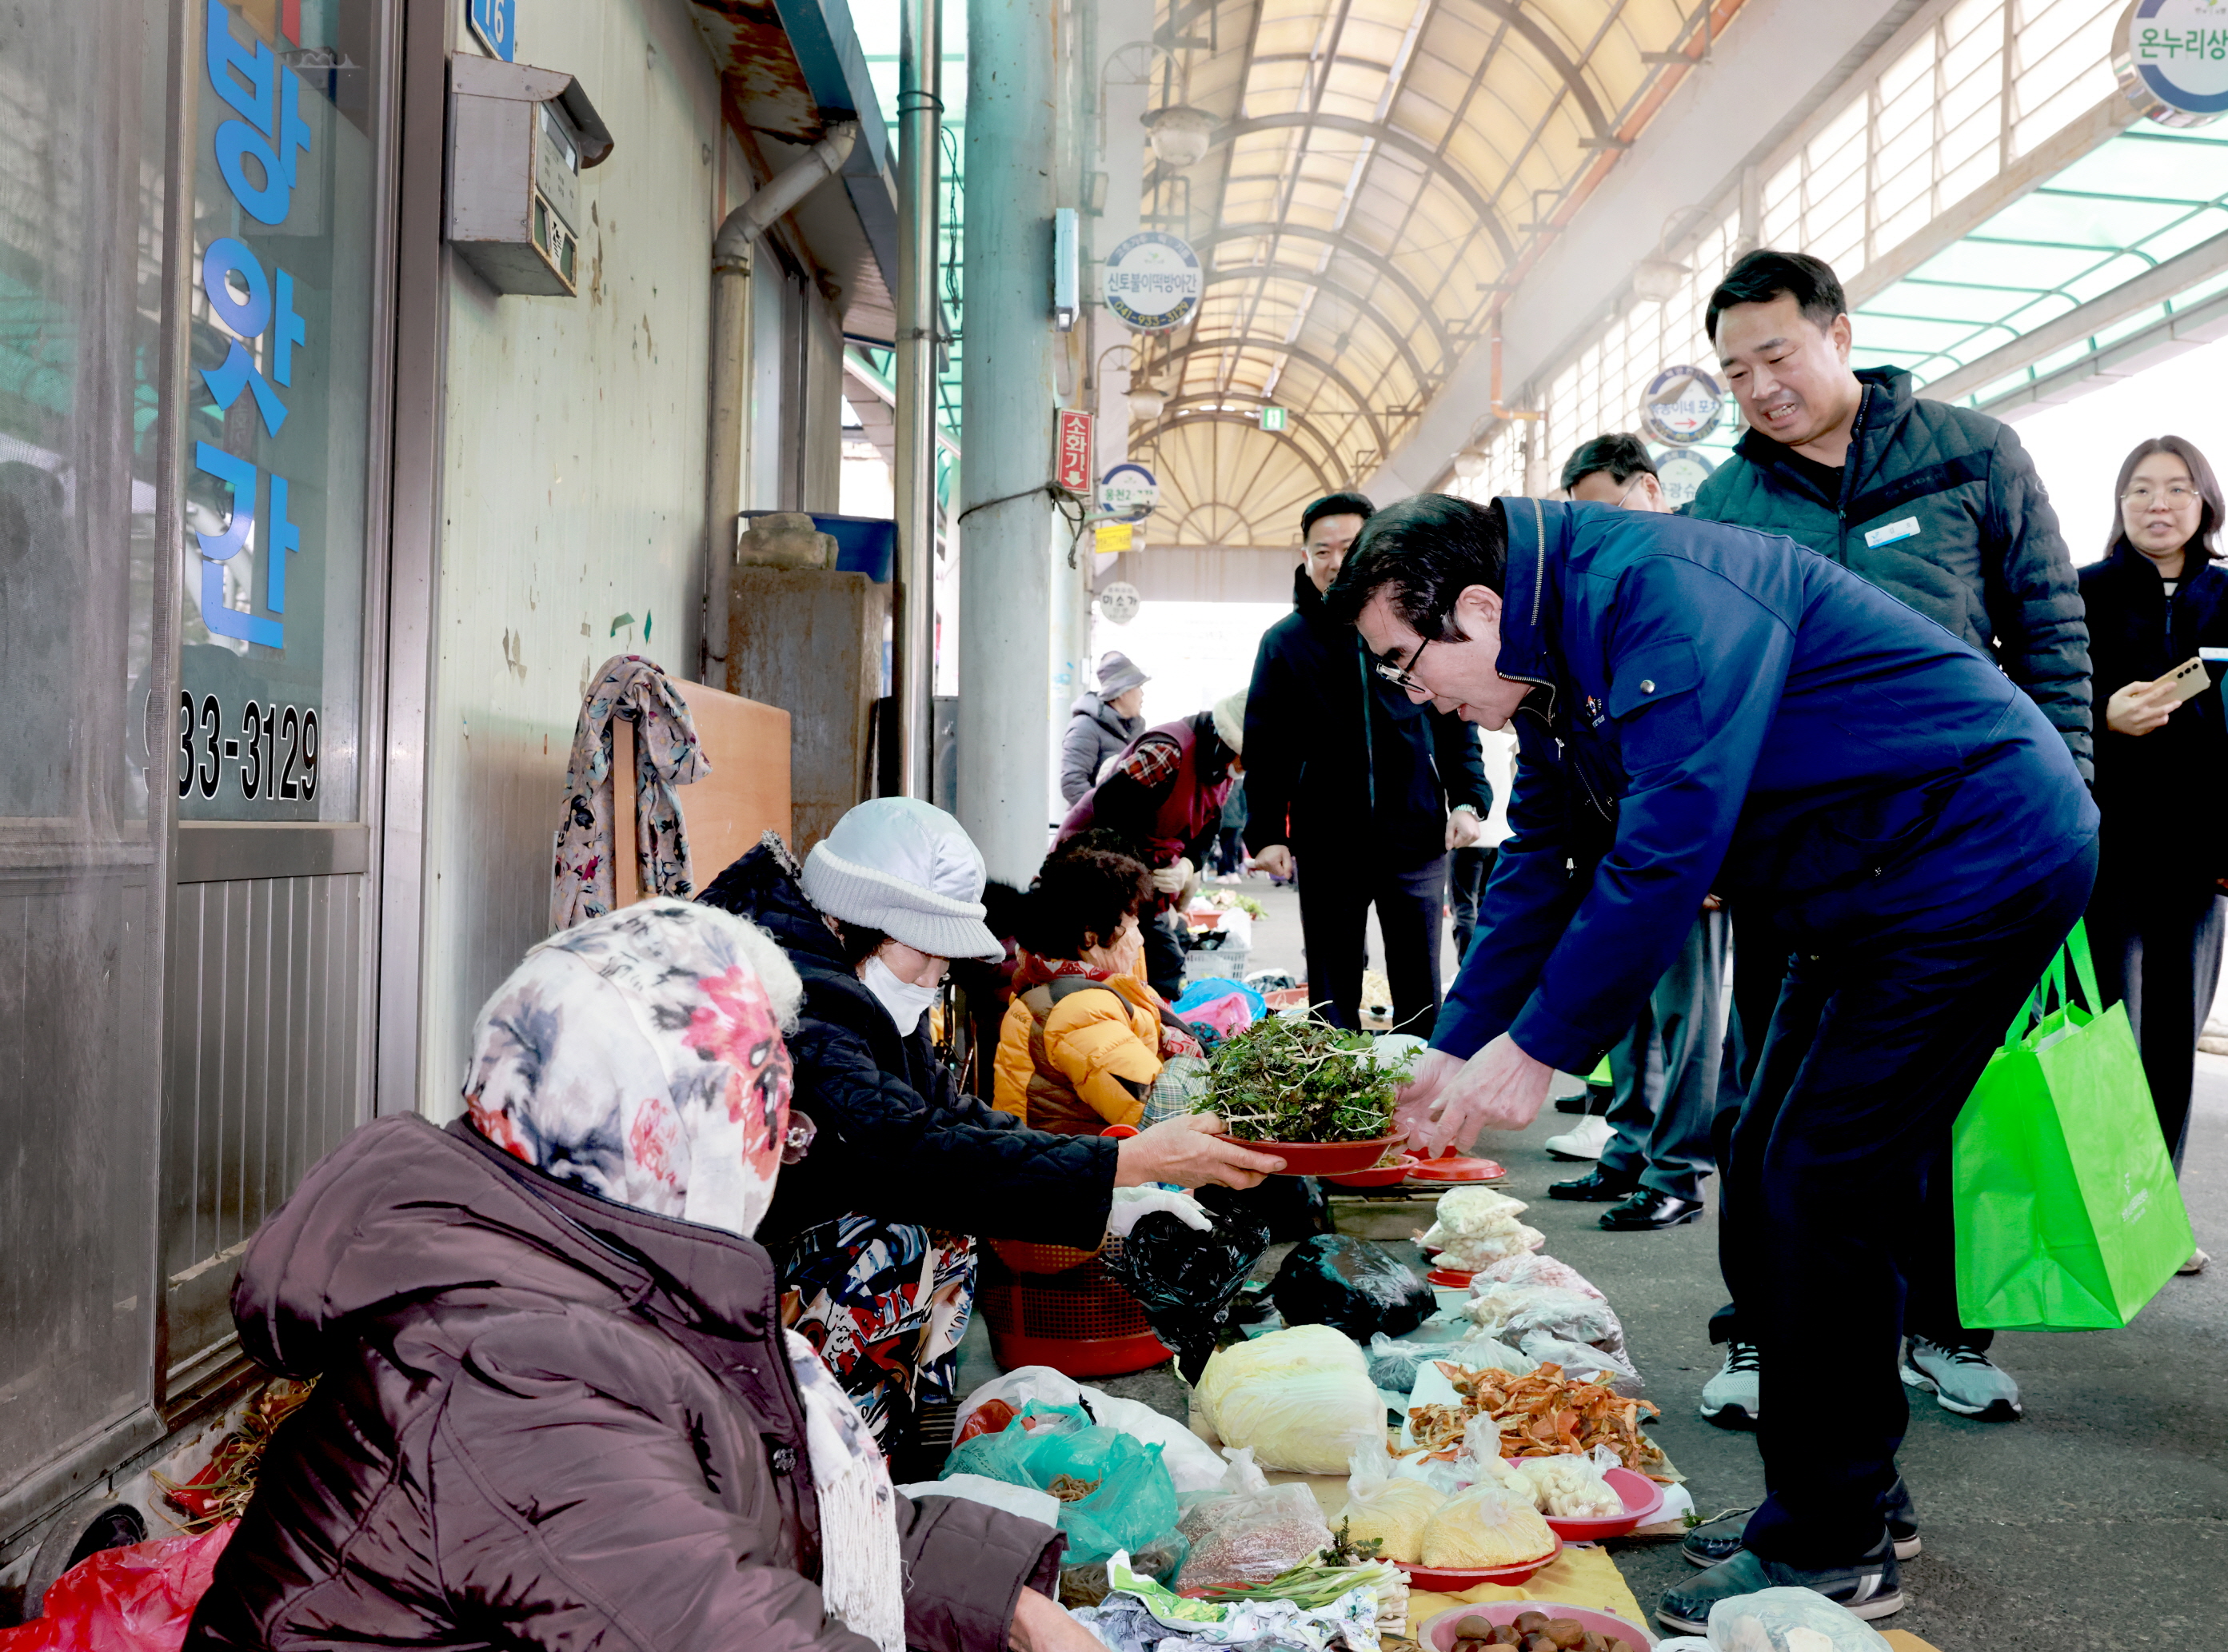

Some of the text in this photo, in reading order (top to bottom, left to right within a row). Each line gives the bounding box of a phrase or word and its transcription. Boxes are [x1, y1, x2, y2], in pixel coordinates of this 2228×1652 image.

[1108, 273, 1197, 293] 신토불이떡방아간
[1113, 301, 1189, 327] 041-933-3129
[1065, 417, 1088, 472] 소화기
[178, 688, 320, 802] 33-3129
